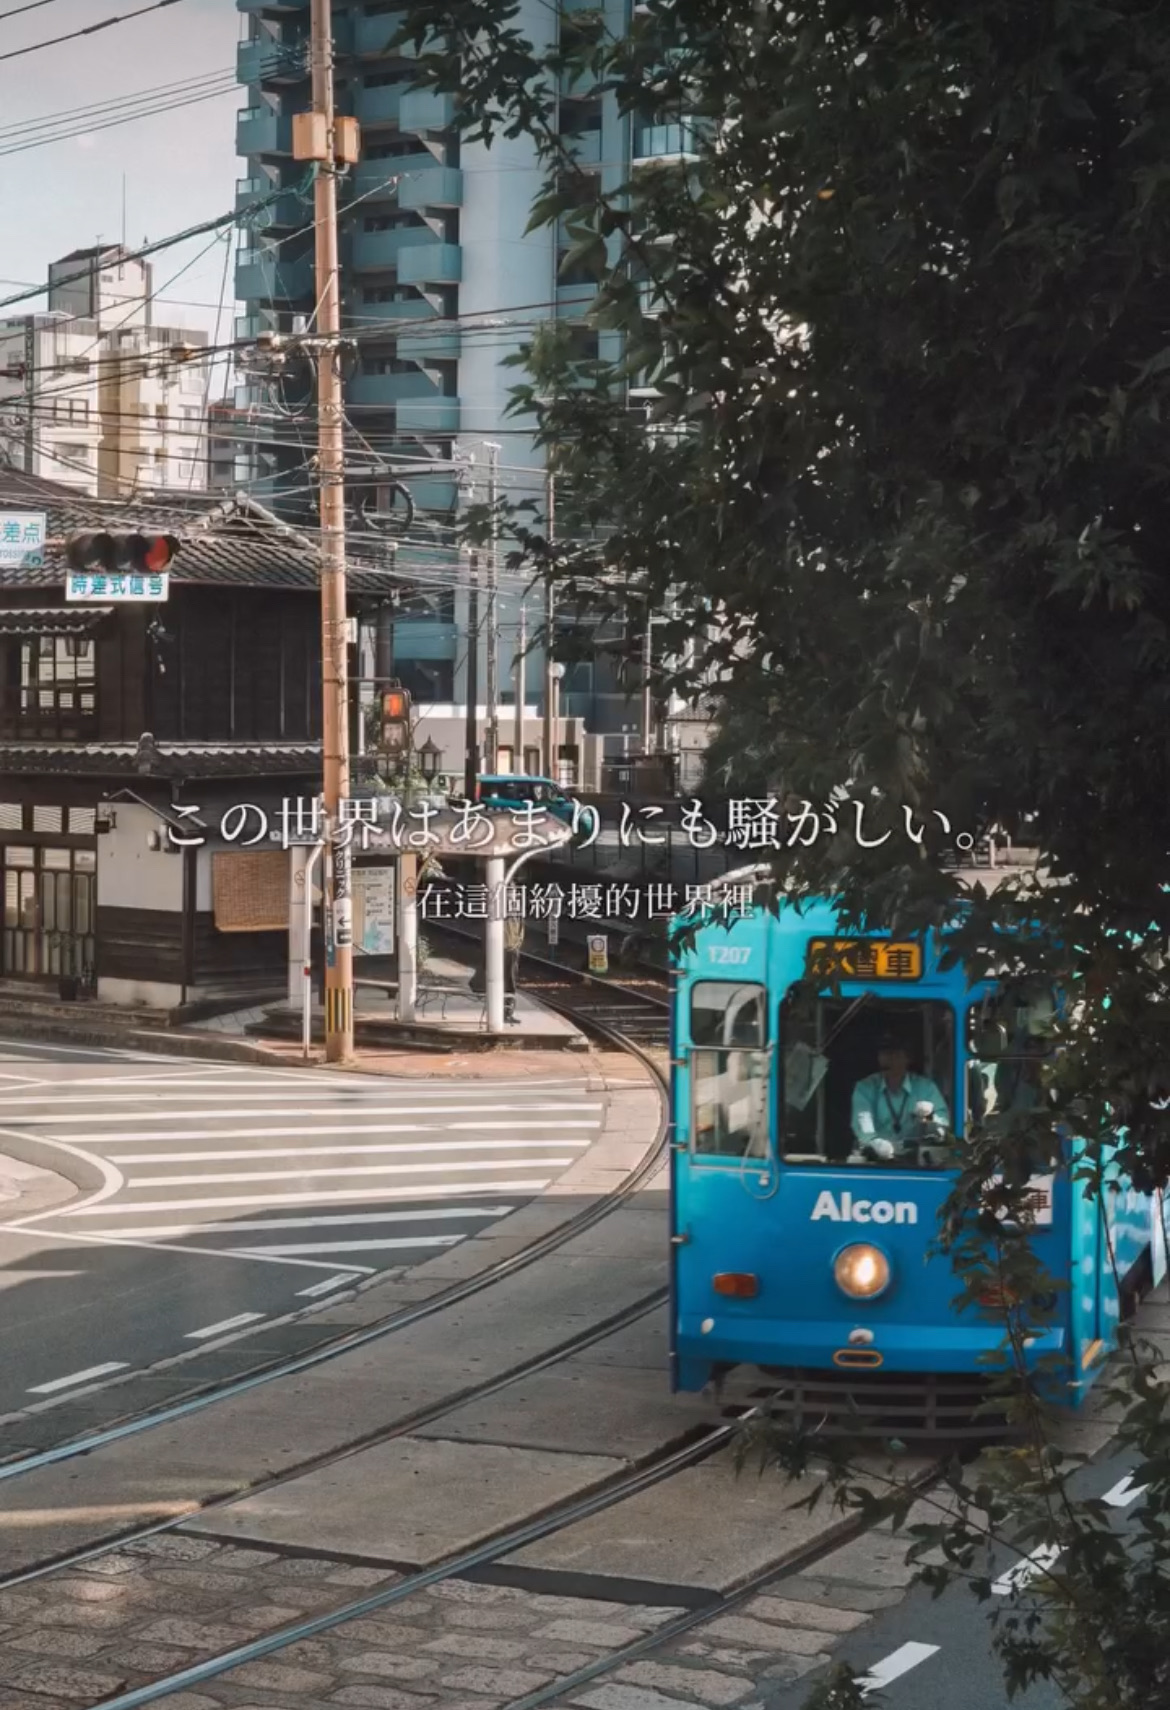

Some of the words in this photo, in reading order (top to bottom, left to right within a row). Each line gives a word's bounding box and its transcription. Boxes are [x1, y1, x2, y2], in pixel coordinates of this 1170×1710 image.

[0, 520, 40, 544] 差点
[71, 575, 163, 595] 時差式信号
[810, 1190, 918, 1224] Alcon
